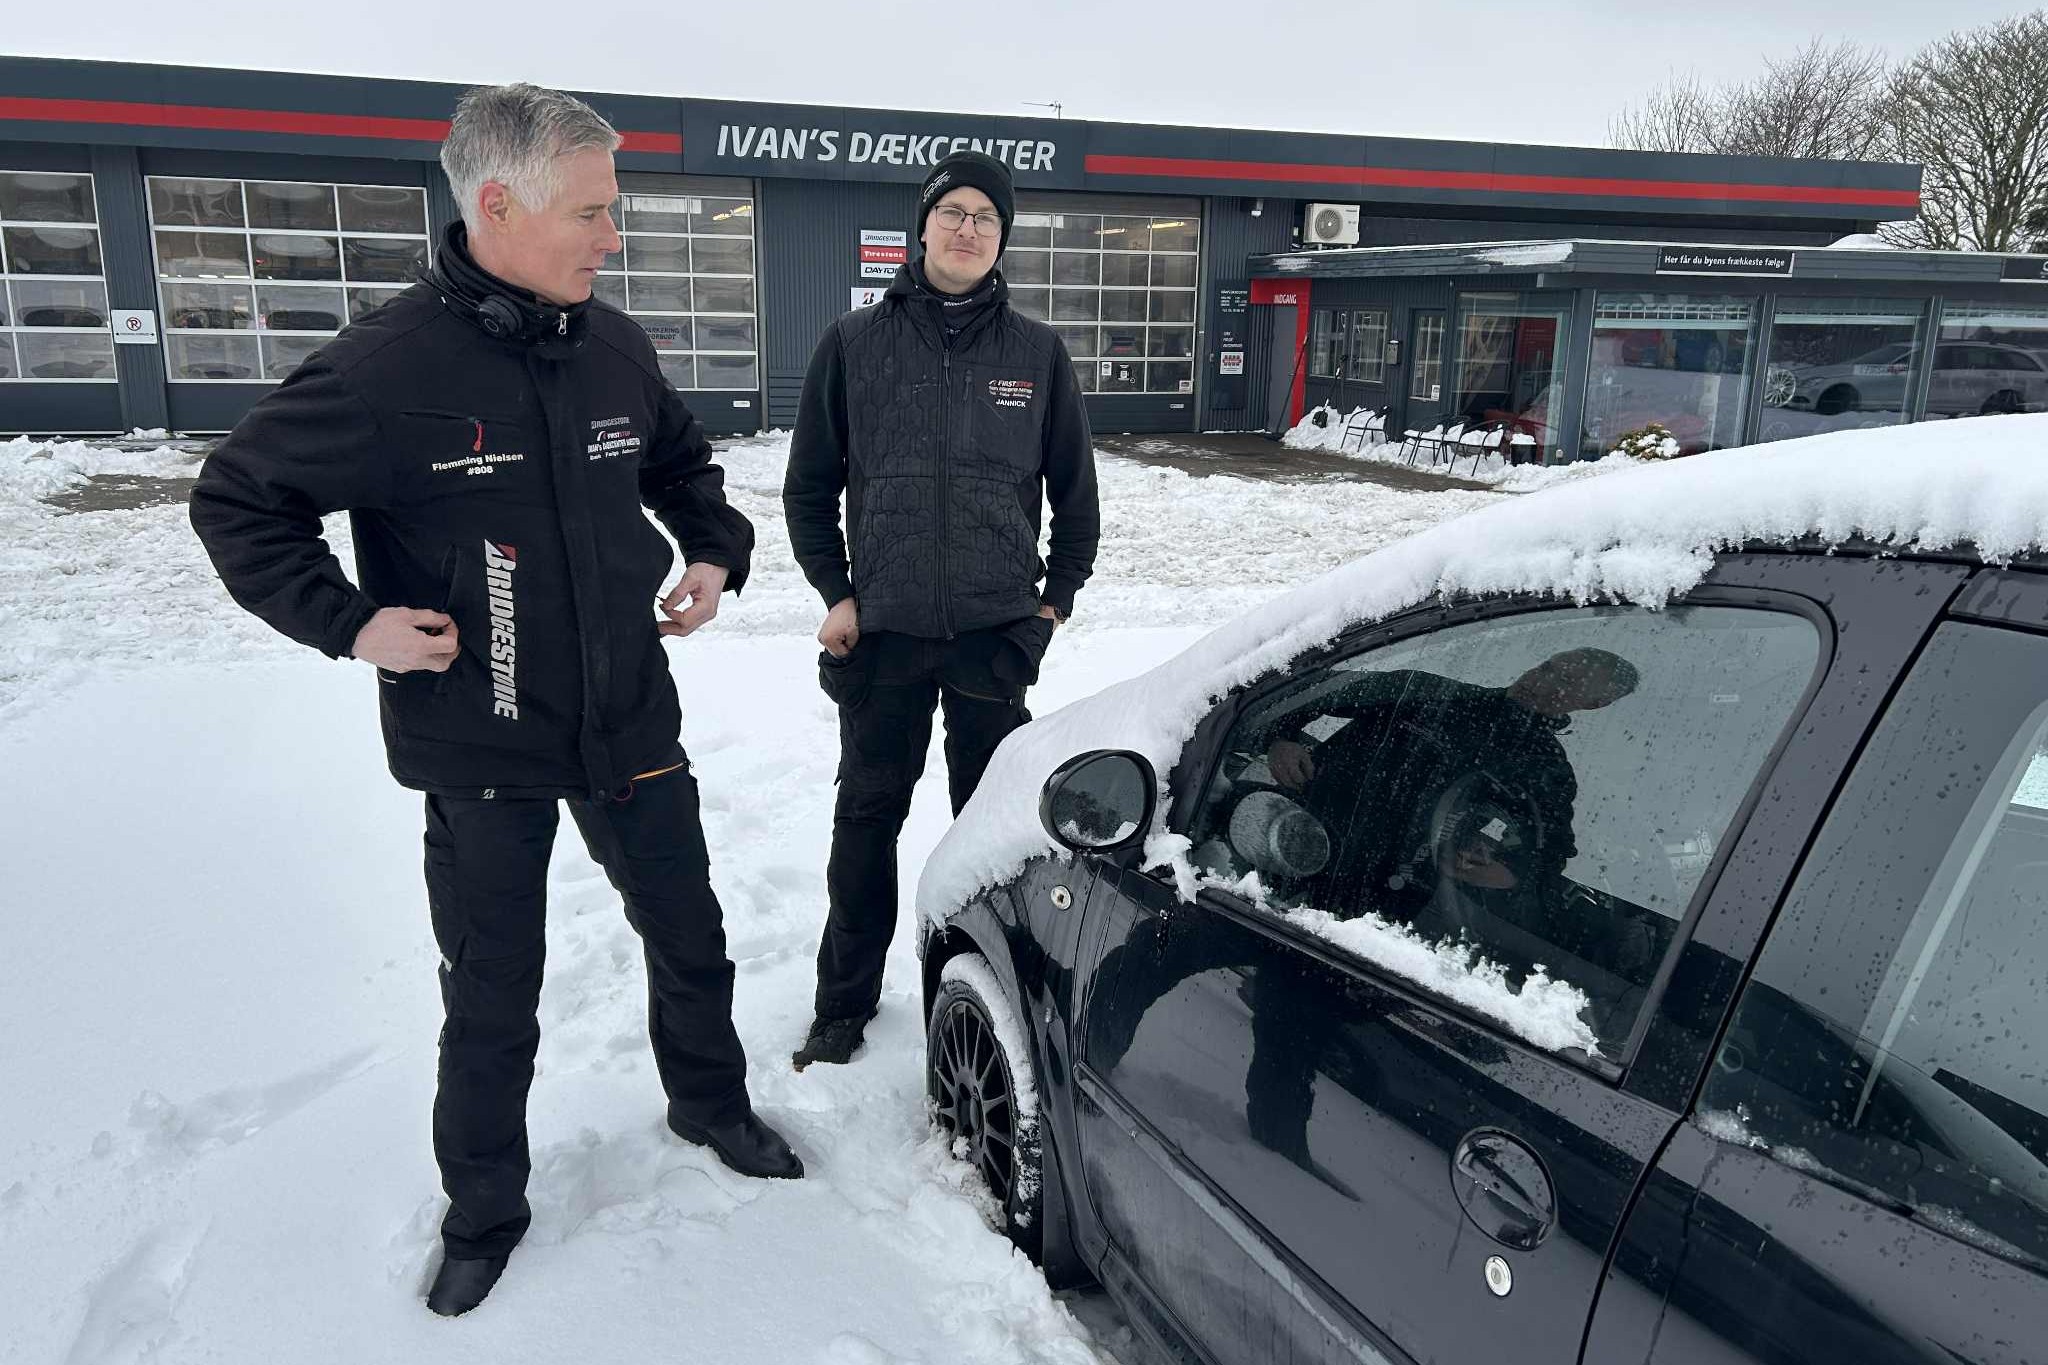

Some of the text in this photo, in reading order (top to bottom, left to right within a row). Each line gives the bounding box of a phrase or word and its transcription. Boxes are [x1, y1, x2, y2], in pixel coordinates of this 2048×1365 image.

[716, 124, 840, 162] IVAN'S
[864, 250, 904, 258] Firestone
[1664, 255, 1785, 268] Her får du byens frækkeste fælge
[864, 266, 898, 274] DAYTO
[995, 399, 1026, 408] JANNICK
[431, 453, 524, 471] Flemming Nielsen
[484, 538, 519, 721] BRIDGESTONE
